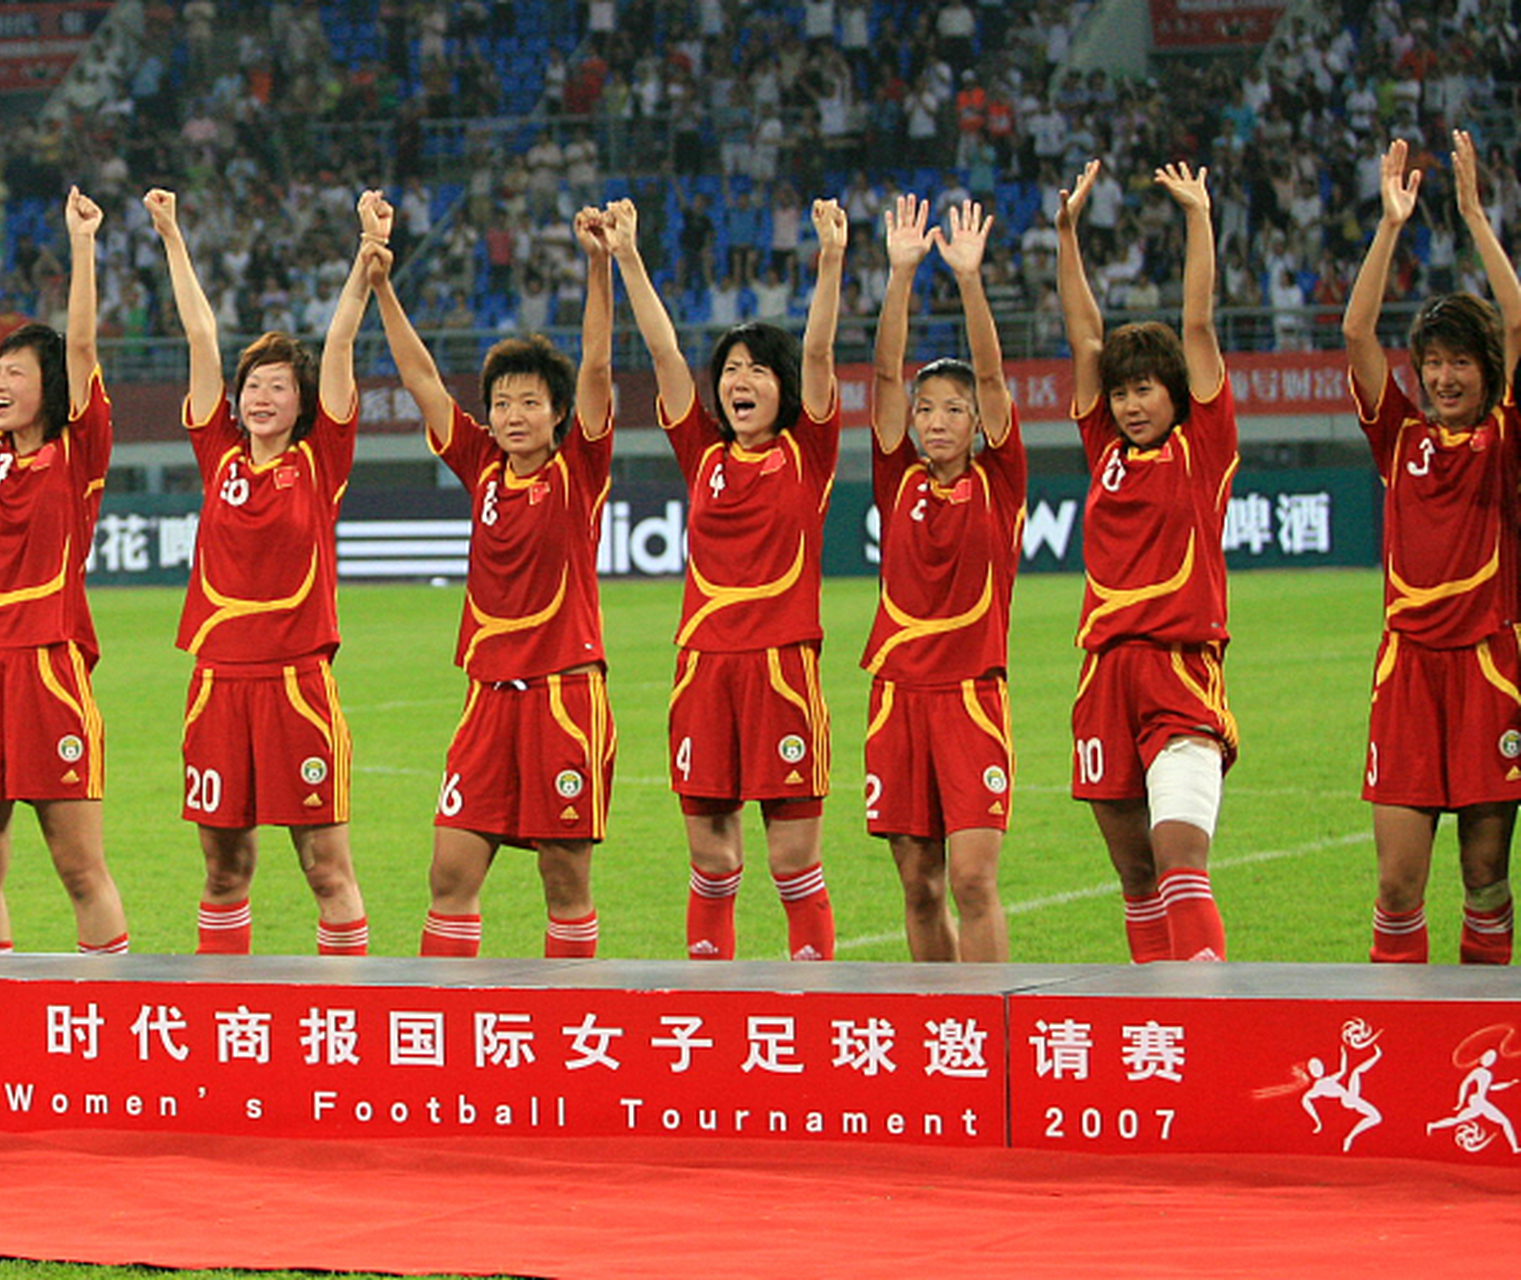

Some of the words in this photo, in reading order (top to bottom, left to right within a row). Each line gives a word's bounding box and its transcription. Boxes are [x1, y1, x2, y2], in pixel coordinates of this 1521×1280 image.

[1221, 492, 1329, 554] 啤酒
[676, 737, 691, 782] 4
[1077, 738, 1104, 784] 10
[186, 764, 222, 813] 20
[46, 1003, 1185, 1082] 时代商报国际女子足球邀请赛
[313, 1091, 565, 1127] Football
[620, 1098, 977, 1136] Tournament
[1045, 1107, 1176, 1140] 2007
